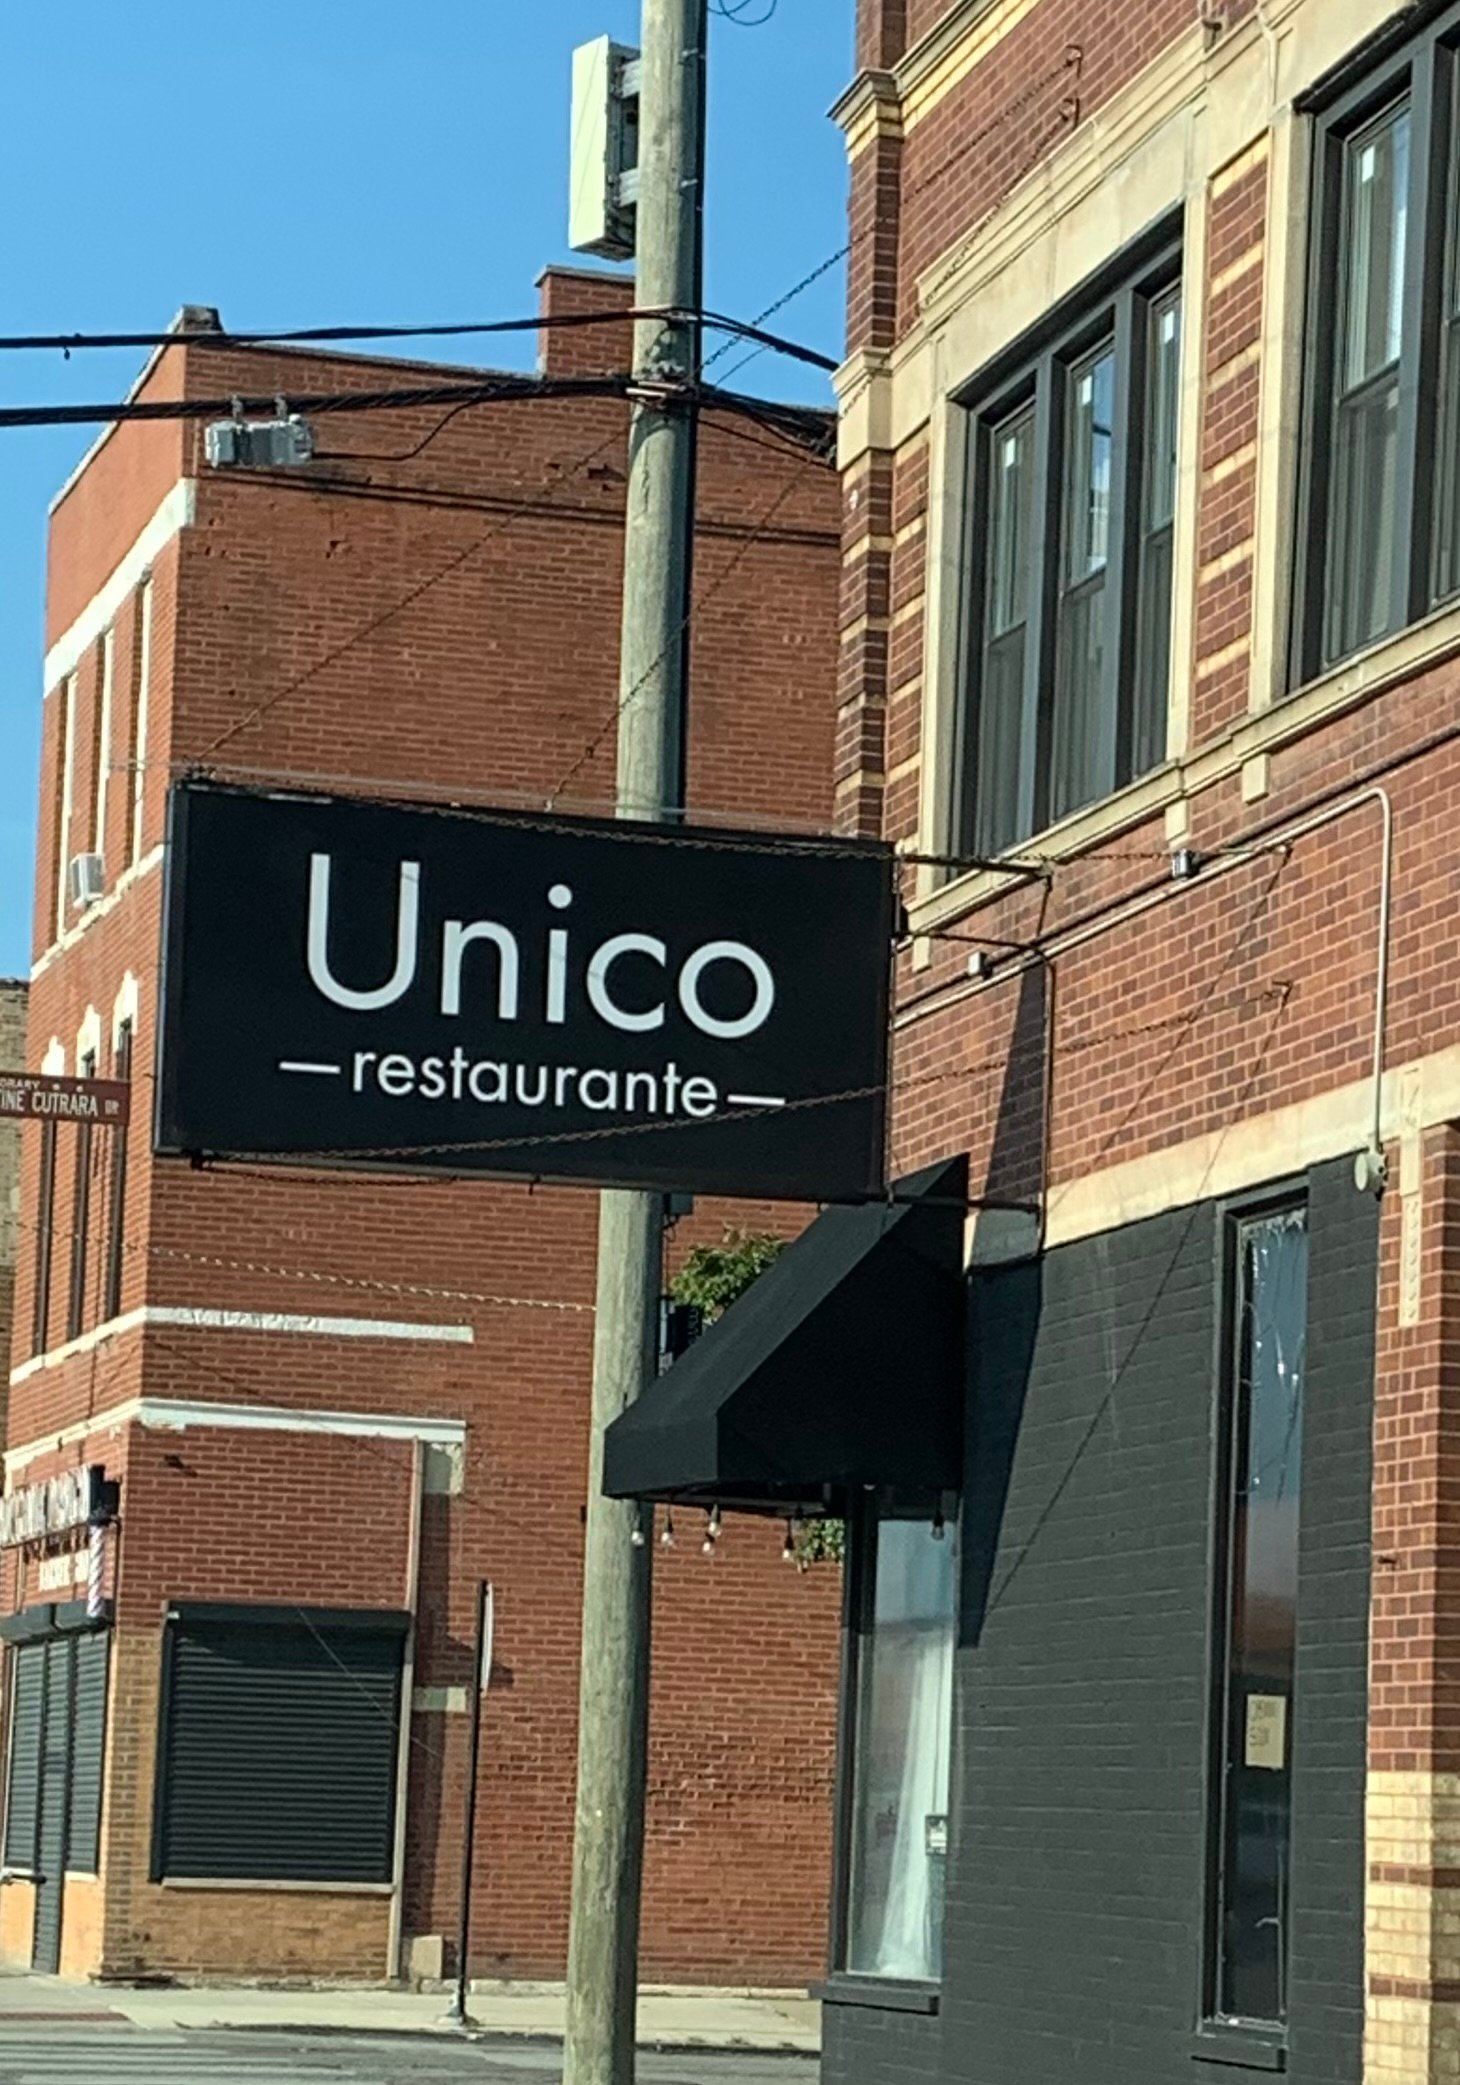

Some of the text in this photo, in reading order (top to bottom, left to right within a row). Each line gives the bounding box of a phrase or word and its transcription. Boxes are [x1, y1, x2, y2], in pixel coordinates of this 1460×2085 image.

[307, 852, 775, 1039] Unico
[32, 1091, 98, 1117] CUTRARA
[352, 1045, 719, 1118] restaurante
